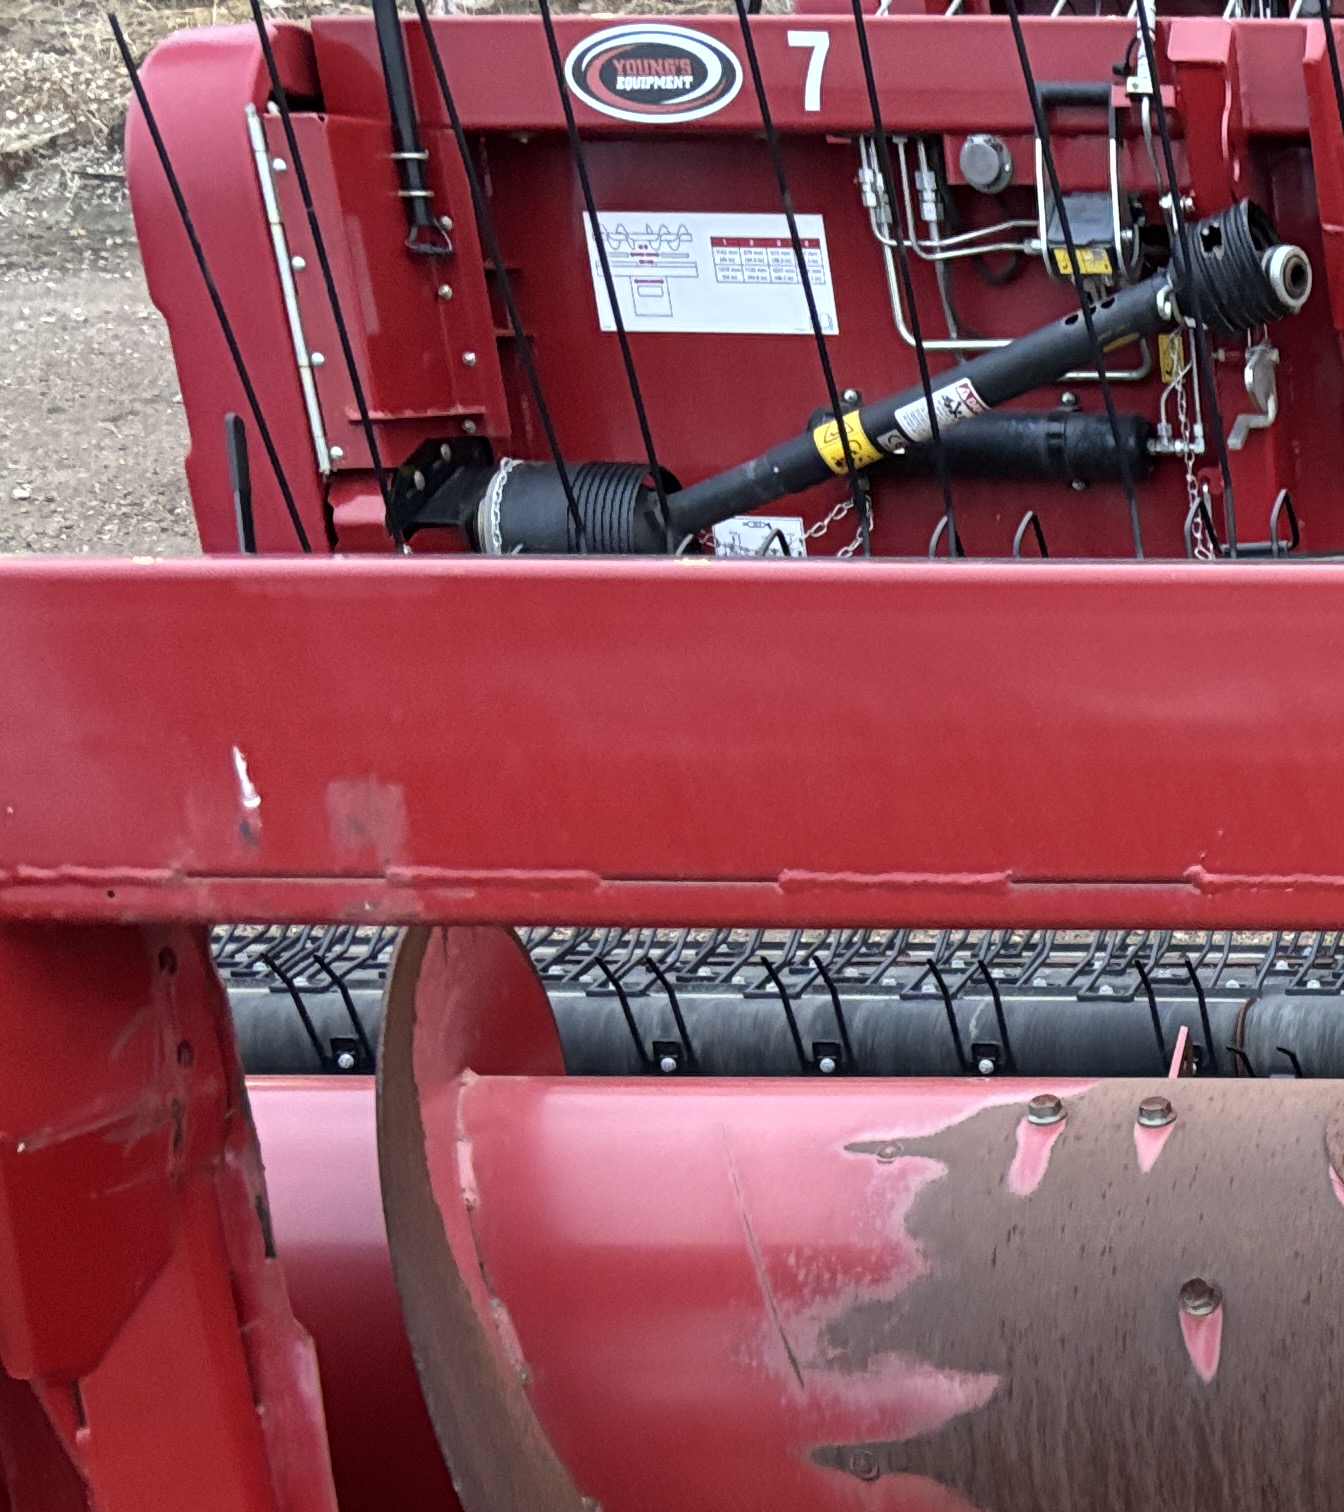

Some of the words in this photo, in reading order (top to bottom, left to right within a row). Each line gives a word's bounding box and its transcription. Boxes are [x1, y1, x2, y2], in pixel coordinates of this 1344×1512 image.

[613, 59, 692, 75] YOUNG'S
[788, 31, 830, 111] 7
[616, 75, 693, 91] EQUIPMENT
